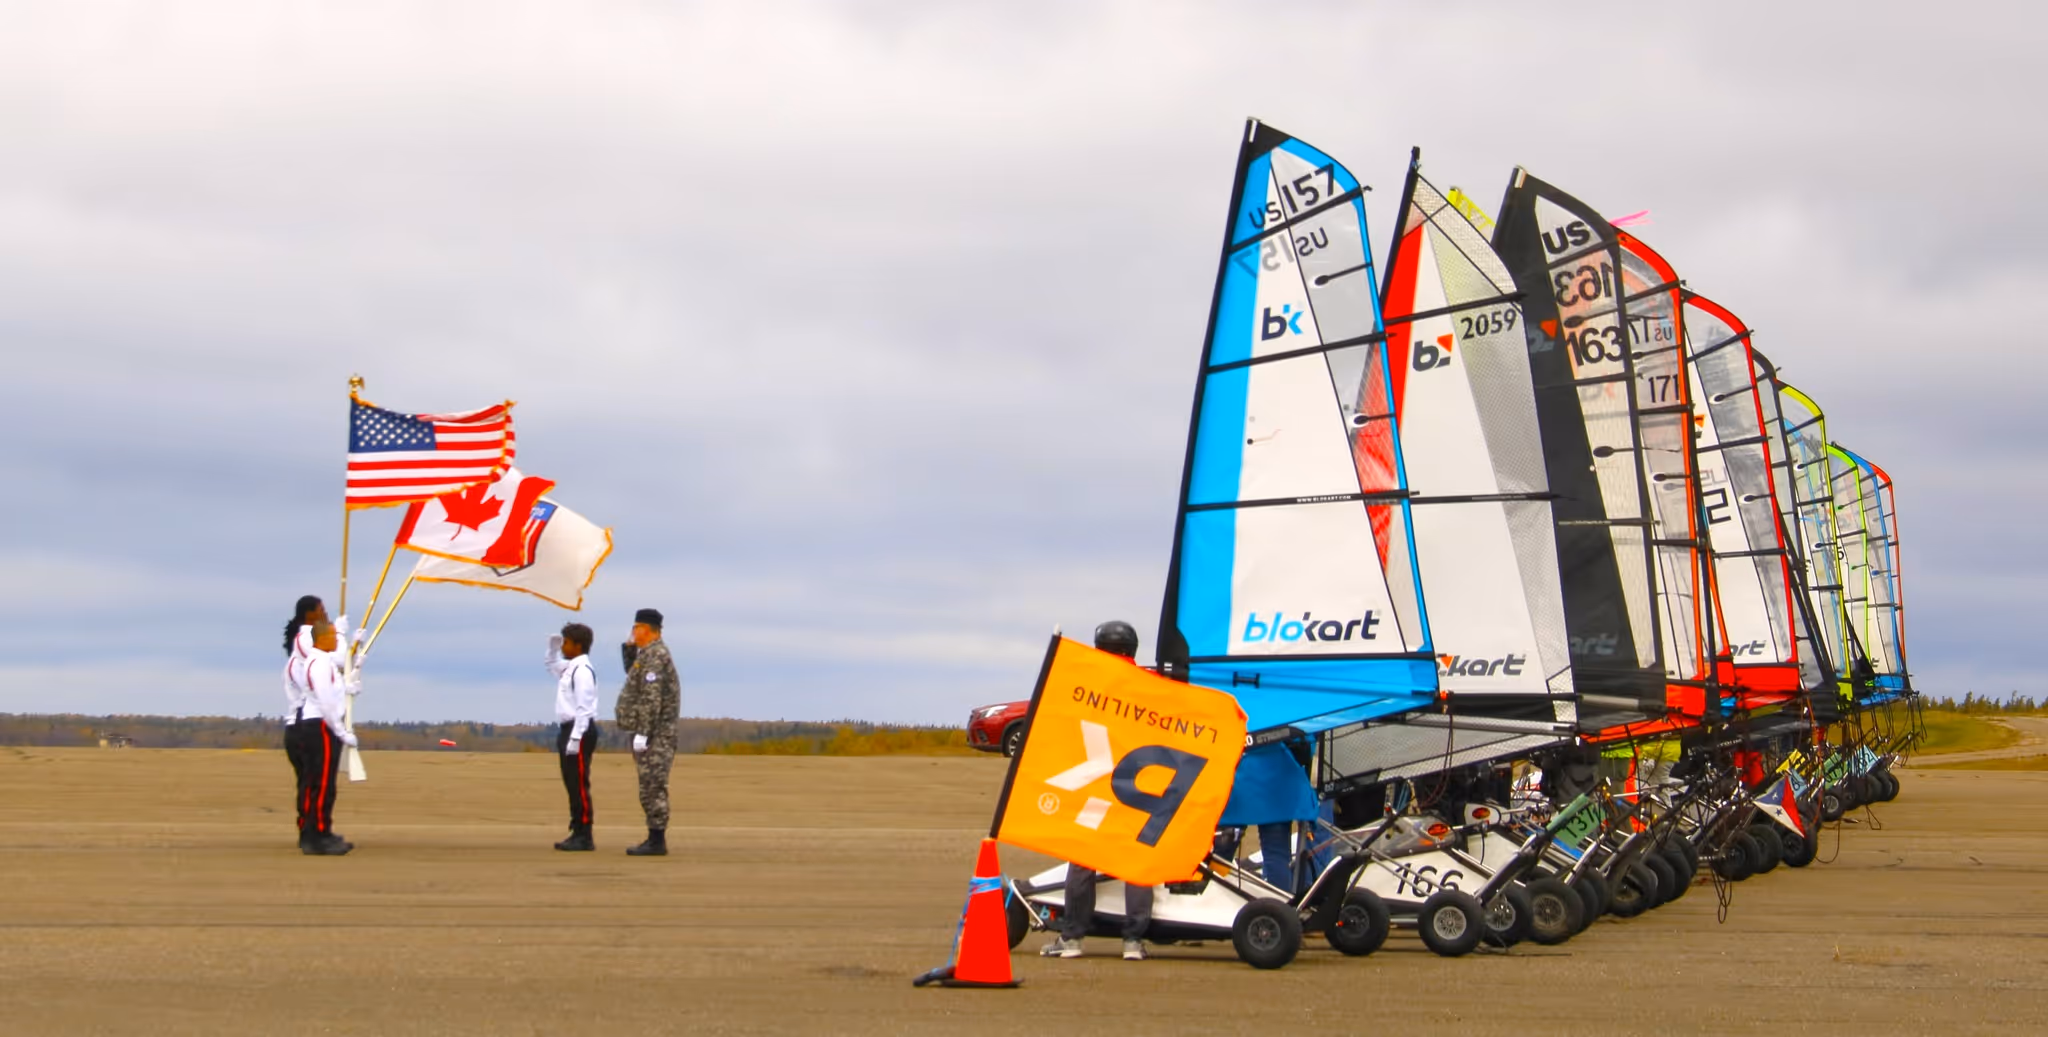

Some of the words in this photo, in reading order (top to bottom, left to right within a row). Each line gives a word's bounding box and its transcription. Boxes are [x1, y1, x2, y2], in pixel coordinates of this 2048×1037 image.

[1249, 201, 1282, 229] US
[1281, 163, 1335, 214] 157
[1542, 220, 1590, 254] US
[1460, 308, 1517, 340] 2059
[1566, 325, 1625, 367] 163
[1648, 373, 1680, 403] 171
[1242, 609, 1381, 642] blokart
[1073, 686, 1218, 744] LANDSAILING
[1394, 862, 1464, 898] 166
